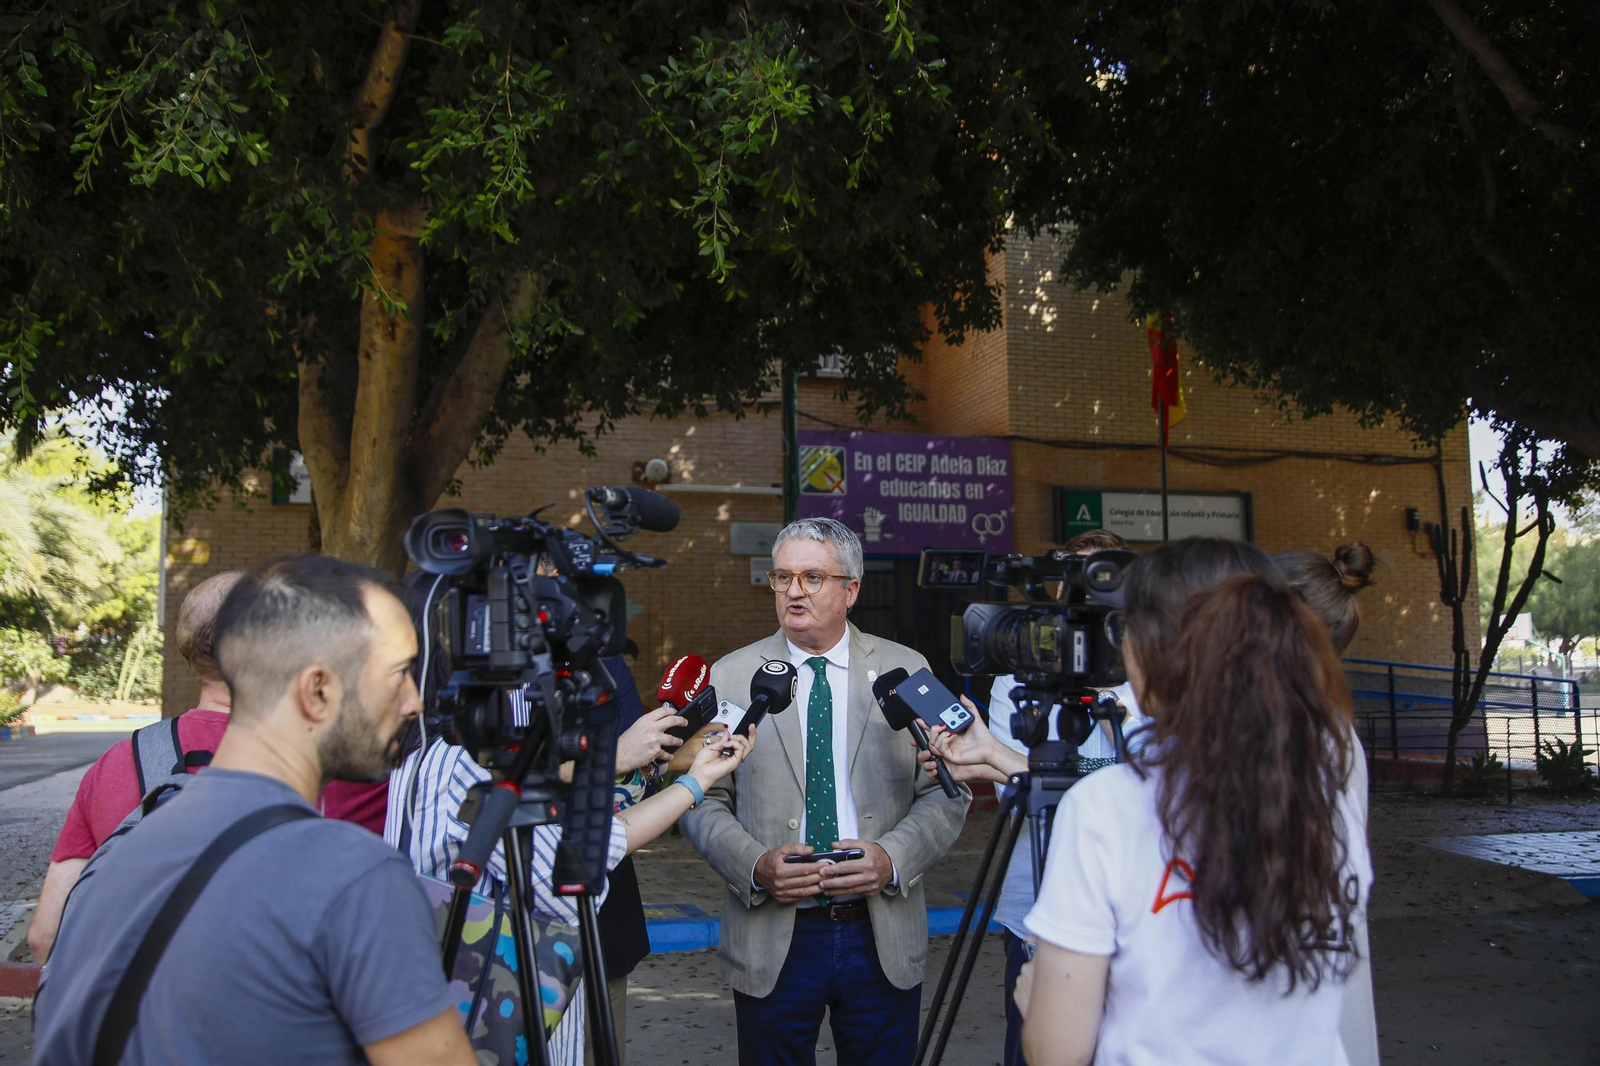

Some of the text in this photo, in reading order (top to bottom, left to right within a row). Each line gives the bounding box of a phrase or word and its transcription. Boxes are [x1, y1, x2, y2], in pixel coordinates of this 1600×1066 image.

[854, 451, 1007, 476] En el CEIP Adela Díaz
[880, 478, 984, 500] educamos en
[898, 502, 967, 524] IGUALDAD
[1109, 507, 1240, 519] Colegio de Edución Infantil y Primaria
